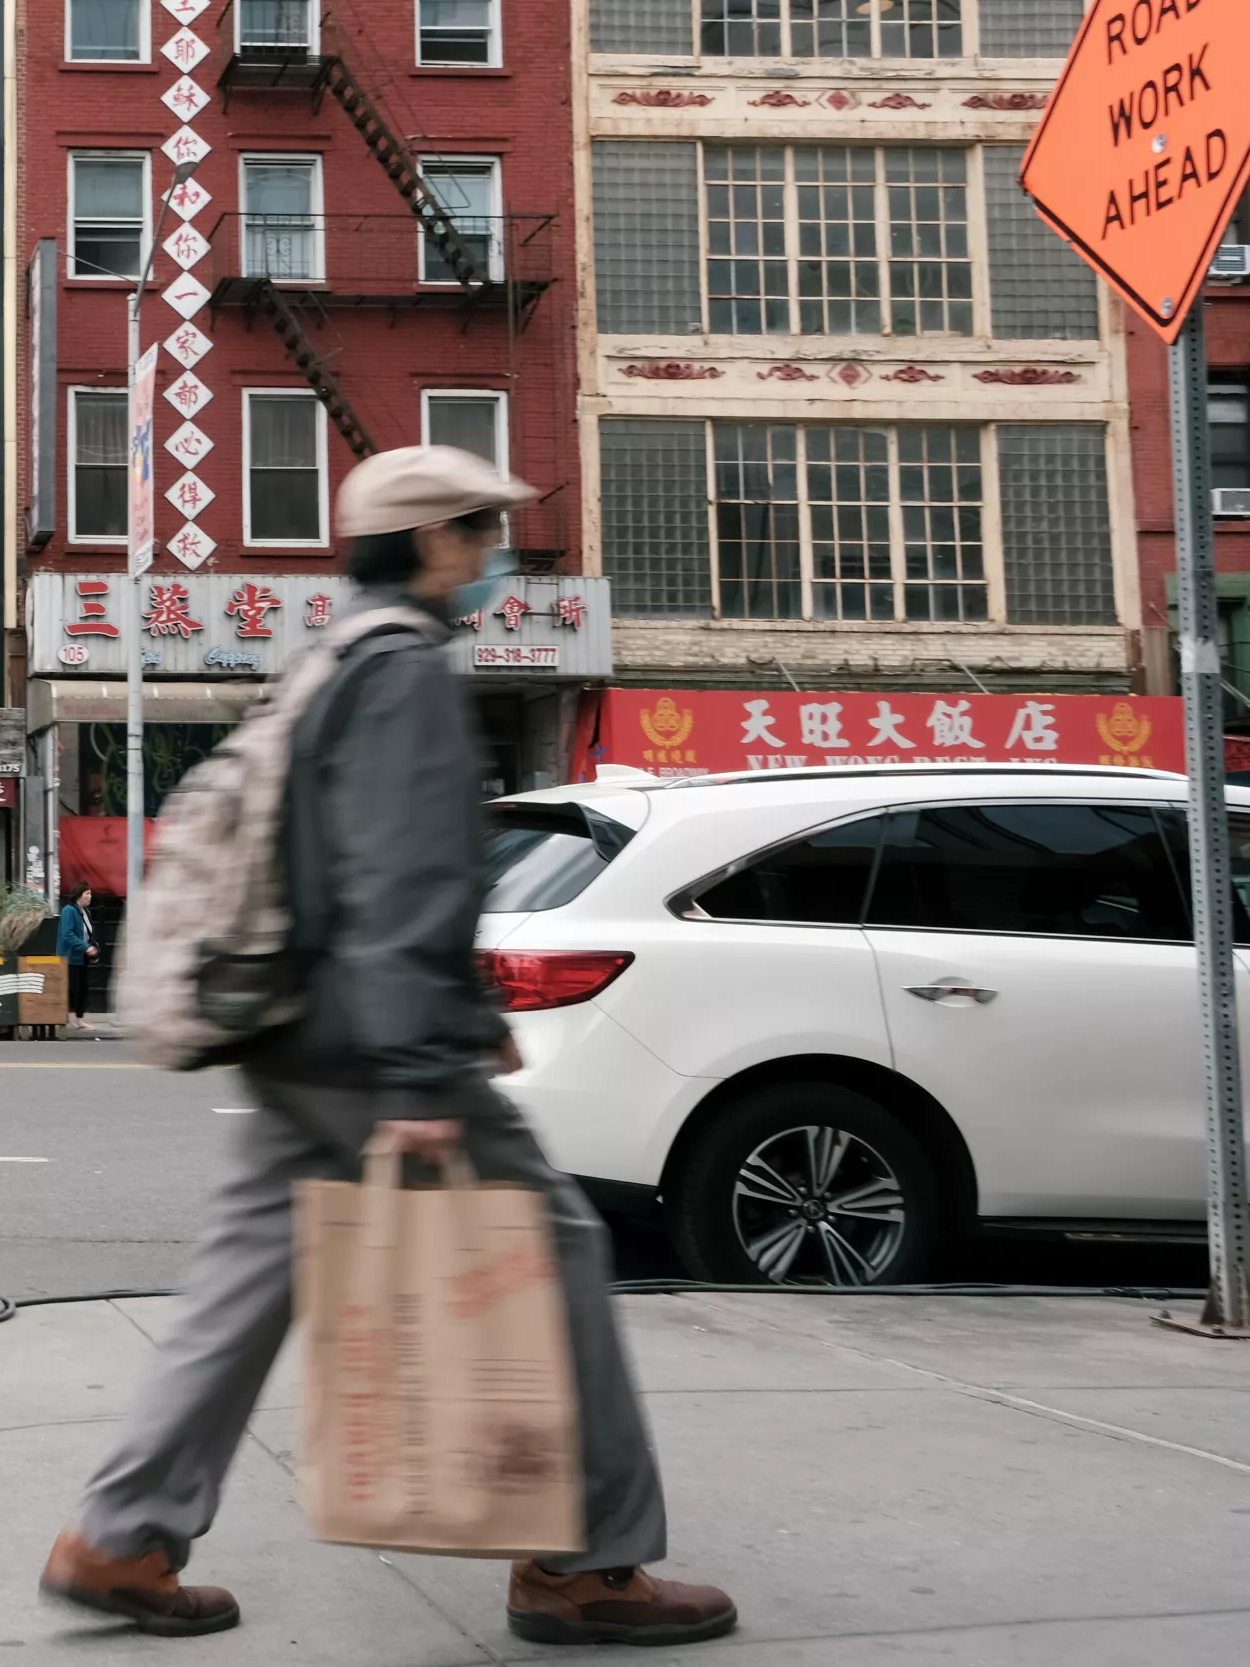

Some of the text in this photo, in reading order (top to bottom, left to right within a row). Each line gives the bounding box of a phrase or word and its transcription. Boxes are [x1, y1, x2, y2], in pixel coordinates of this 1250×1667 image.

[1106, 0, 1201, 65] ROA
[1109, 42, 1211, 147] WORK
[1101, 128, 1228, 241] AHEAD
[64, 580, 283, 638] 三蒸堂
[62, 645, 85, 663] 105
[477, 648, 556, 663] 929-318-3777
[740, 699, 1060, 750] 天旺大飯店
